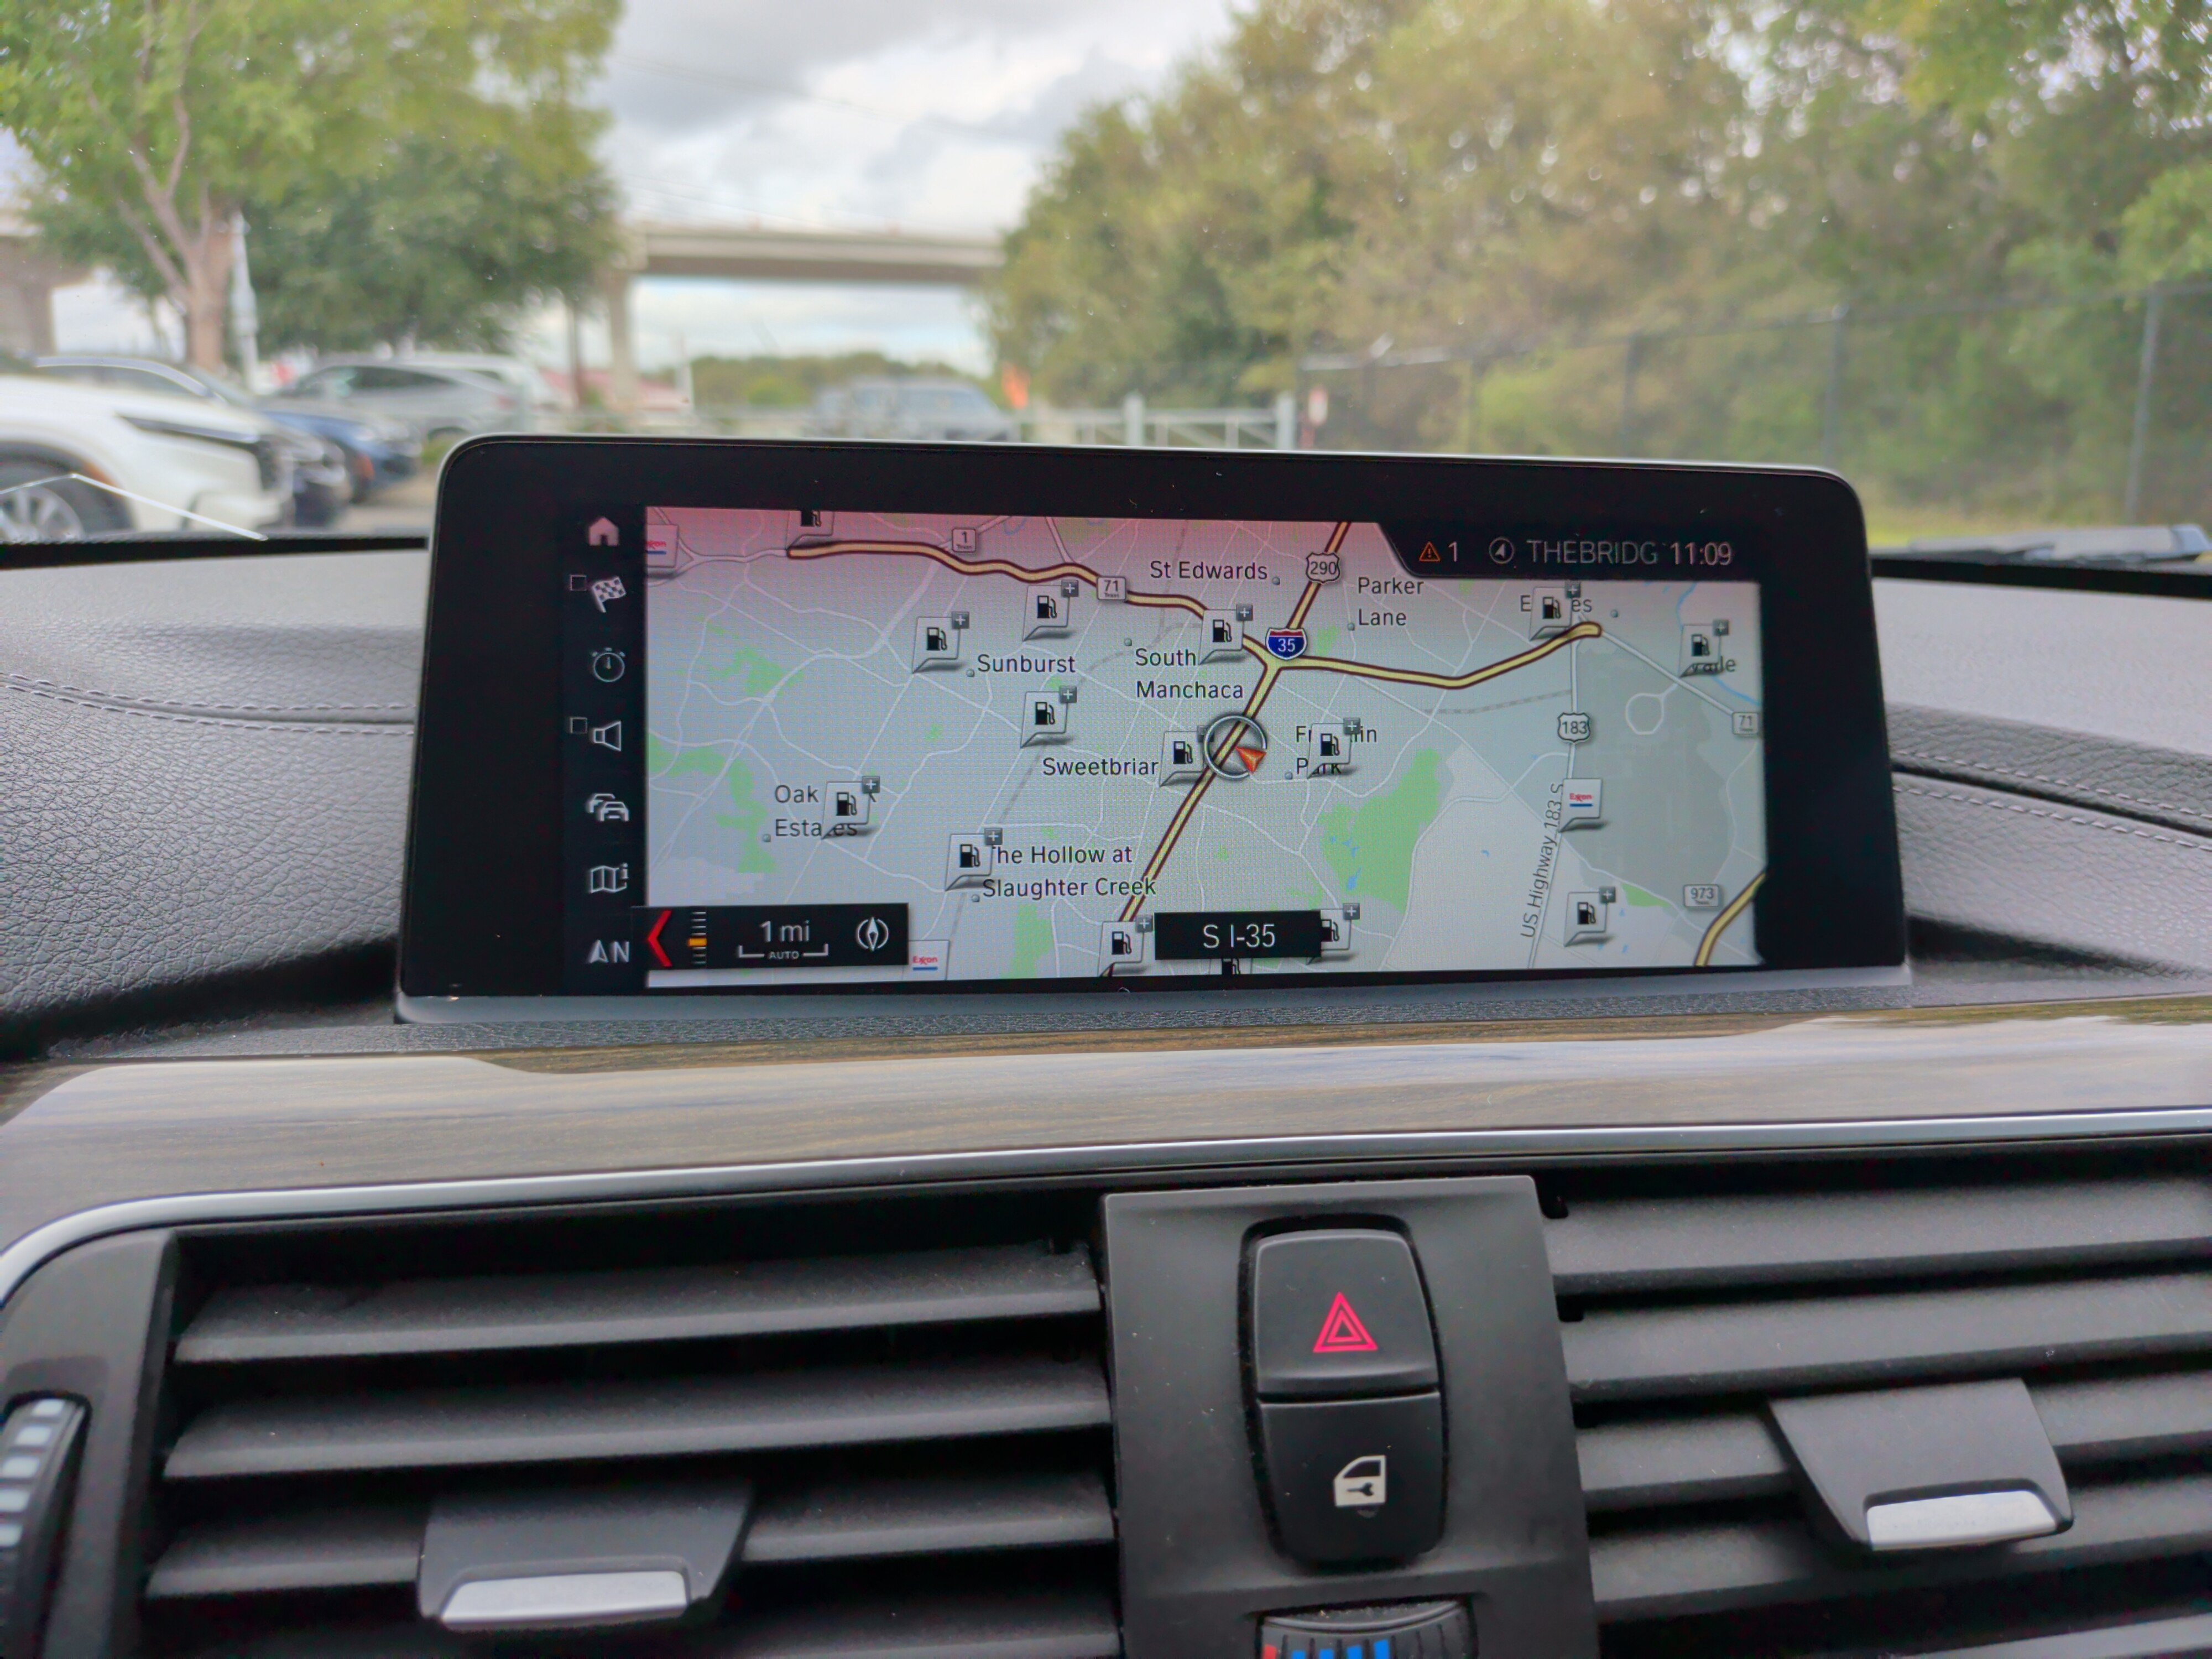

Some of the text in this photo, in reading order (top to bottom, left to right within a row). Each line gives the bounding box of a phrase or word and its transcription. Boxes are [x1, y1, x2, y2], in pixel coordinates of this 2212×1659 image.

[961, 531, 967, 543] 1
[1448, 542, 1458, 562] 1
[1527, 539, 1658, 564] THEBRIDG
[1670, 542, 1733, 565] 11:09
[1150, 561, 1267, 580] St Edwards
[1310, 561, 1337, 575] 290
[1104, 580, 1118, 591] 71
[1358, 577, 1423, 594] Parker
[1359, 609, 1406, 626] Lane
[1278, 638, 1295, 652] 35
[978, 655, 1075, 674] Sunburst
[1136, 649, 1196, 667] South
[1136, 681, 1243, 698] Manchaca
[1562, 721, 1587, 734] 183
[1043, 758, 1159, 776] Sweetbriar
[775, 785, 819, 803] Oak
[1545, 800, 1563, 828] 183
[776, 818, 858, 836] Estaes
[1031, 846, 1105, 864] Hollow
[1112, 847, 1133, 863] at
[1527, 835, 1558, 908] Highway
[983, 878, 1156, 900] Slaughter Creek
[1691, 888, 1714, 899] 973
[760, 920, 810, 942] 1 mi
[1520, 912, 1540, 937] US
[1202, 924, 1276, 949] S I-35
[768, 951, 799, 960] AUTO
